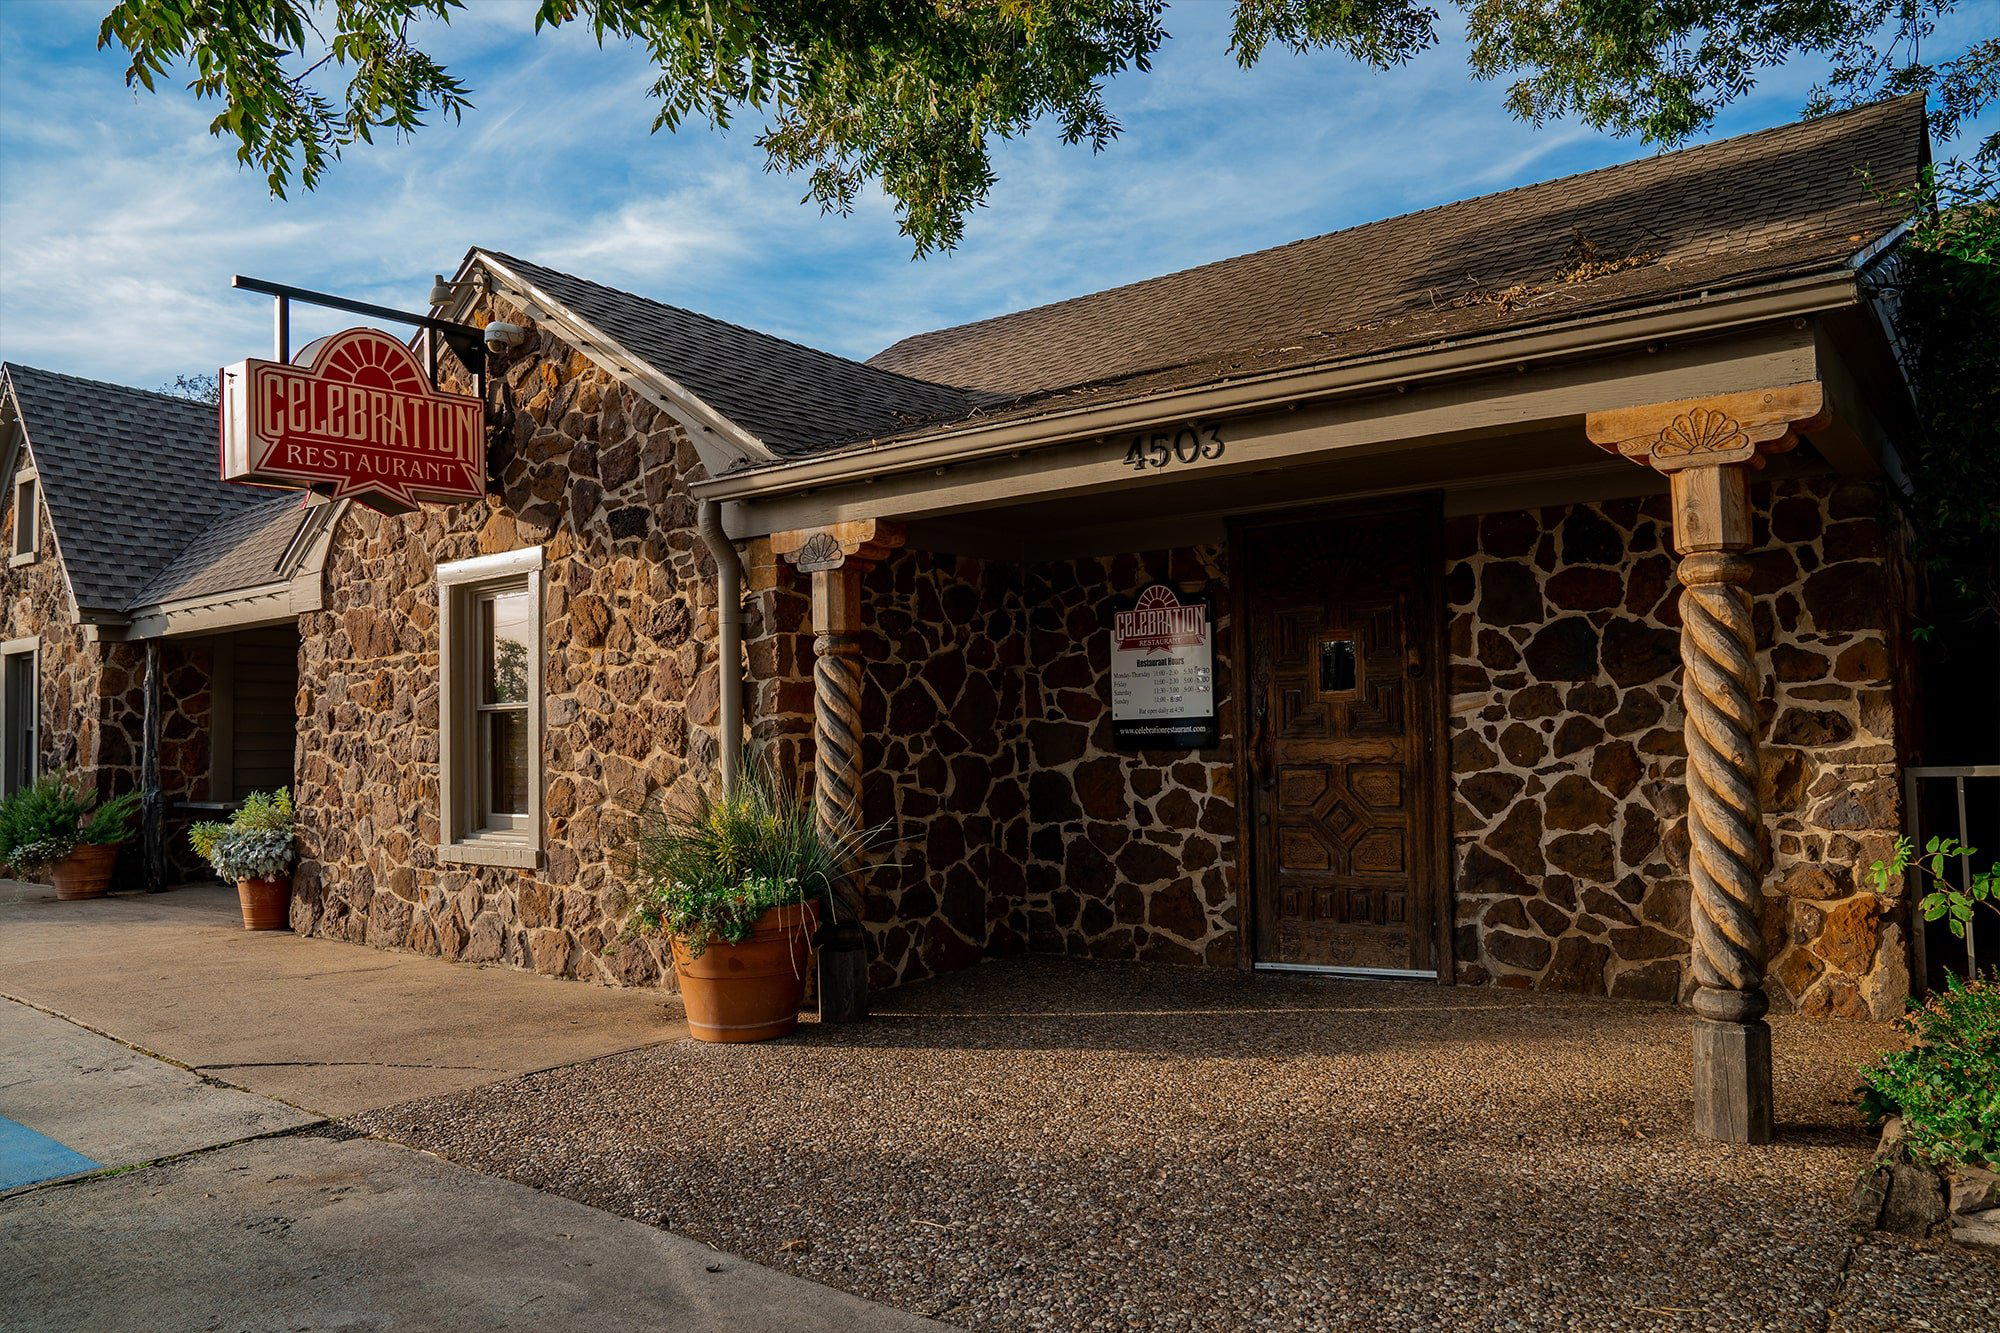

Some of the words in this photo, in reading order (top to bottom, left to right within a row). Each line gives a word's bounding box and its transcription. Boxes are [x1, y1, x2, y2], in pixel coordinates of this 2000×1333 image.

[1122, 423, 1225, 470] 4503
[287, 444, 456, 482] RESTAURANT
[1139, 637, 1181, 647] RESTAURANT
[1136, 658, 1167, 668] Restaurant
[1167, 657, 1184, 666] Hours
[1113, 689, 1132, 697] Saturday
[1114, 698, 1130, 706] Sunday
[1119, 724, 1206, 735] www.celebrationrestaurant.com
